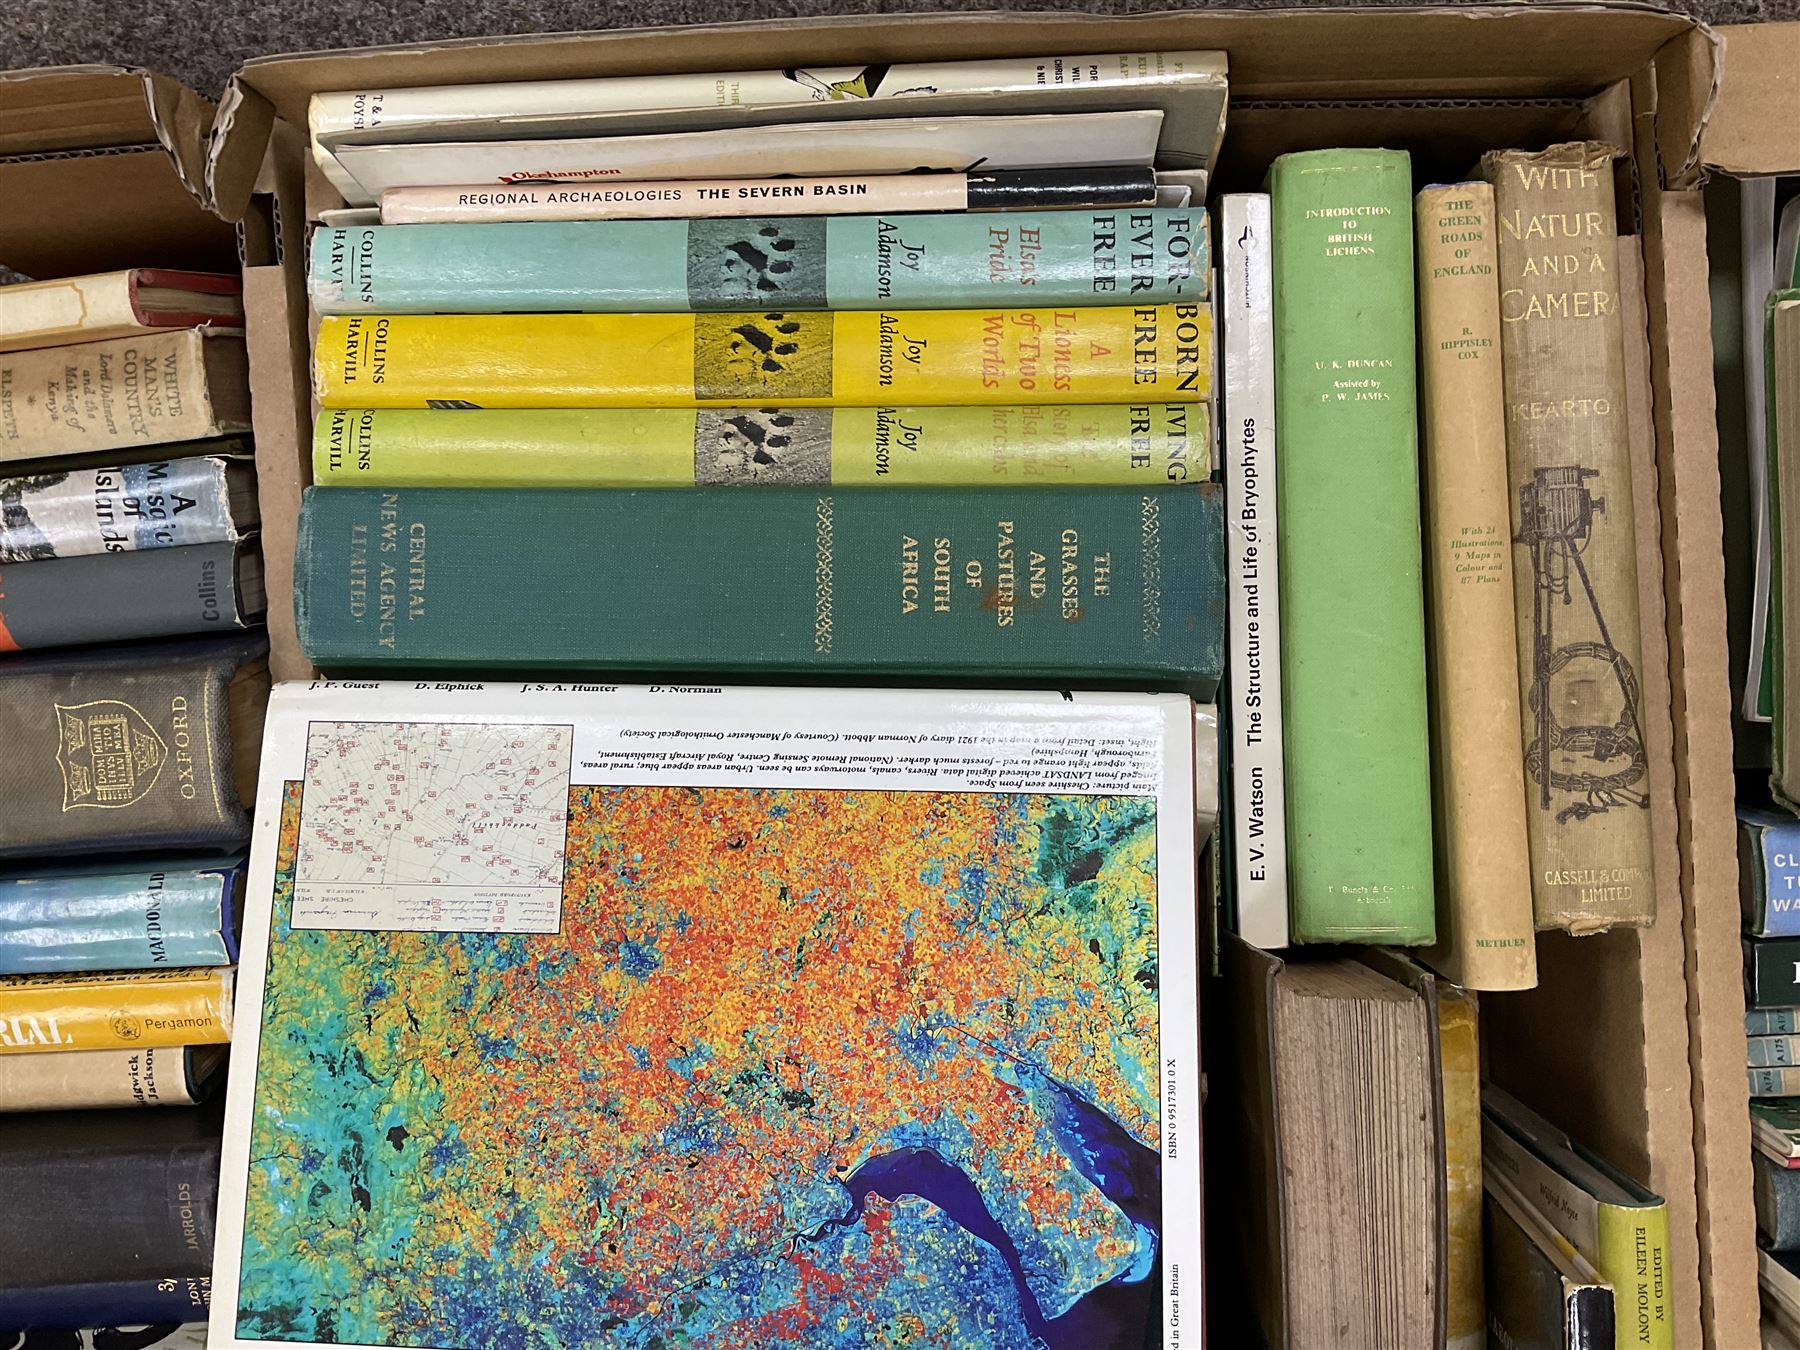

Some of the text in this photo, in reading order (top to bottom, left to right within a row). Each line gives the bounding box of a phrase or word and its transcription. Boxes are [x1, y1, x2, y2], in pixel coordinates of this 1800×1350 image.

[510, 168, 622, 181] Okehampton
[1515, 164, 1599, 191] WITH
[459, 183, 868, 206] REGIONAL ARCHAEOLOGIES THE SEVERN BASIN
[1306, 206, 1392, 219] INTRODUCTION
[1445, 200, 1473, 210] THE
[1342, 220, 1357, 229] TO
[1438, 216, 1481, 228] GREEN
[1328, 233, 1372, 243] BRITISH
[1440, 232, 1482, 244] ROADS
[878, 219, 898, 299] Adamson
[900, 238, 925, 272] Joy
[988, 226, 1010, 284] Pride
[1092, 216, 1116, 294] FREE
[1130, 214, 1154, 296] EVER
[1166, 218, 1190, 295] FOR-
[1326, 246, 1374, 256] LICHENS
[1454, 249, 1471, 258] OF
[360, 230, 375, 303] COLLINS
[1434, 265, 1492, 278] ENGLAND
[1521, 253, 1606, 277] AND A
[344, 318, 362, 384] HARVILL
[372, 318, 390, 384] COLLINS
[879, 314, 898, 387] Adamson
[902, 335, 928, 364] Joy
[982, 312, 1006, 390] Worlds
[1012, 312, 1040, 390] of Two
[1054, 310, 1077, 392] Lioness
[1090, 340, 1112, 360] A
[1134, 307, 1158, 386] FREE
[1176, 304, 1199, 392] BORN
[1440, 338, 1492, 350] HIPPISLEY
[1348, 360, 1392, 368] DUNCAN
[1458, 350, 1479, 360] COX
[124, 348, 150, 438] COUNTRY
[144, 356, 162, 418] MAN'S
[164, 352, 182, 417] WHITE
[1333, 380, 1381, 388] Assisted by
[2, 368, 19, 440] ELSPETH
[46, 380, 60, 422] Kenya
[62, 365, 86, 432] Making of
[1354, 392, 1390, 400] JAMES
[875, 407, 897, 476] Adamson
[898, 418, 923, 452] Joy
[1129, 406, 1150, 470] FREE
[95, 466, 130, 552] Islands
[122, 497, 148, 520] of
[170, 494, 196, 516] A
[1462, 526, 1482, 535] With
[1466, 551, 1490, 561] Maps
[350, 524, 368, 617] LIMITED
[378, 493, 398, 649] NEWS AGENCY
[409, 522, 426, 621] CENTRAL
[902, 534, 920, 614] AFRICA
[934, 536, 951, 613] SOUTH
[966, 560, 982, 588] OF
[1030, 550, 1046, 598] AND
[1062, 528, 1078, 620] GRASSES
[1094, 552, 1111, 596] THE
[1455, 564, 1485, 572] Colour
[198, 560, 220, 622] Collins
[1240, 418, 1262, 746] The Structure and Life of Bryophytes
[434, 682, 485, 692] Elphick
[520, 684, 532, 693] J.
[619, 729, 978, 744] 1921 diary Norman (Courtesy Manchester Ornithological Society)
[172, 696, 196, 800] OXFORD
[598, 750, 667, 760] Establishment,
[669, 752, 706, 761] Aircraft
[708, 752, 734, 762] Royal
[737, 752, 770, 762] Centre,
[773, 752, 810, 763] Sensing
[610, 762, 634, 770] rural
[662, 761, 694, 770] appear
[724, 764, 754, 772] Urban
[812, 754, 847, 764] Remote
[814, 764, 866, 774] motorways
[896, 756, 935, 765] darker.
[962, 755, 994, 765] forests
[1033, 756, 1066, 766] orange
[1068, 757, 1090, 768] light
[1092, 758, 1126, 767] appear
[782, 765, 792, 774] be
[904, 766, 938, 776] Rivers,
[941, 768, 964, 777] data.
[966, 767, 997, 778] digital
[999, 769, 1041, 778] achieved
[1043, 770, 1092, 779] LANDSAT
[1094, 770, 1119, 780] from
[967, 779, 997, 789] Space.
[999, 779, 1024, 789] from
[1049, 781, 1090, 791] Cheshire
[1093, 781, 1129, 791] picture:
[1248, 767, 1265, 882] E. V. Watson
[1545, 870, 1598, 885] CASSELL
[1581, 887, 1632, 903] LIMITED
[146, 872, 168, 962] MACDONALD
[1475, 938, 1526, 948] METHUEN
[146, 1018, 212, 1031] Pergamon
[144, 1048, 159, 1100] Jackson
[1166, 1059, 1177, 1160] ISBN 9517301 X
[178, 1183, 199, 1250] JARROLDS
[1170, 1264, 1179, 1296] Britain
[1635, 1227, 1650, 1344] EILEEN MOLONY
[1652, 1247, 1665, 1322] EDITED BY
[1170, 1300, 1179, 1327] Great
[1170, 1330, 1180, 1340] in
